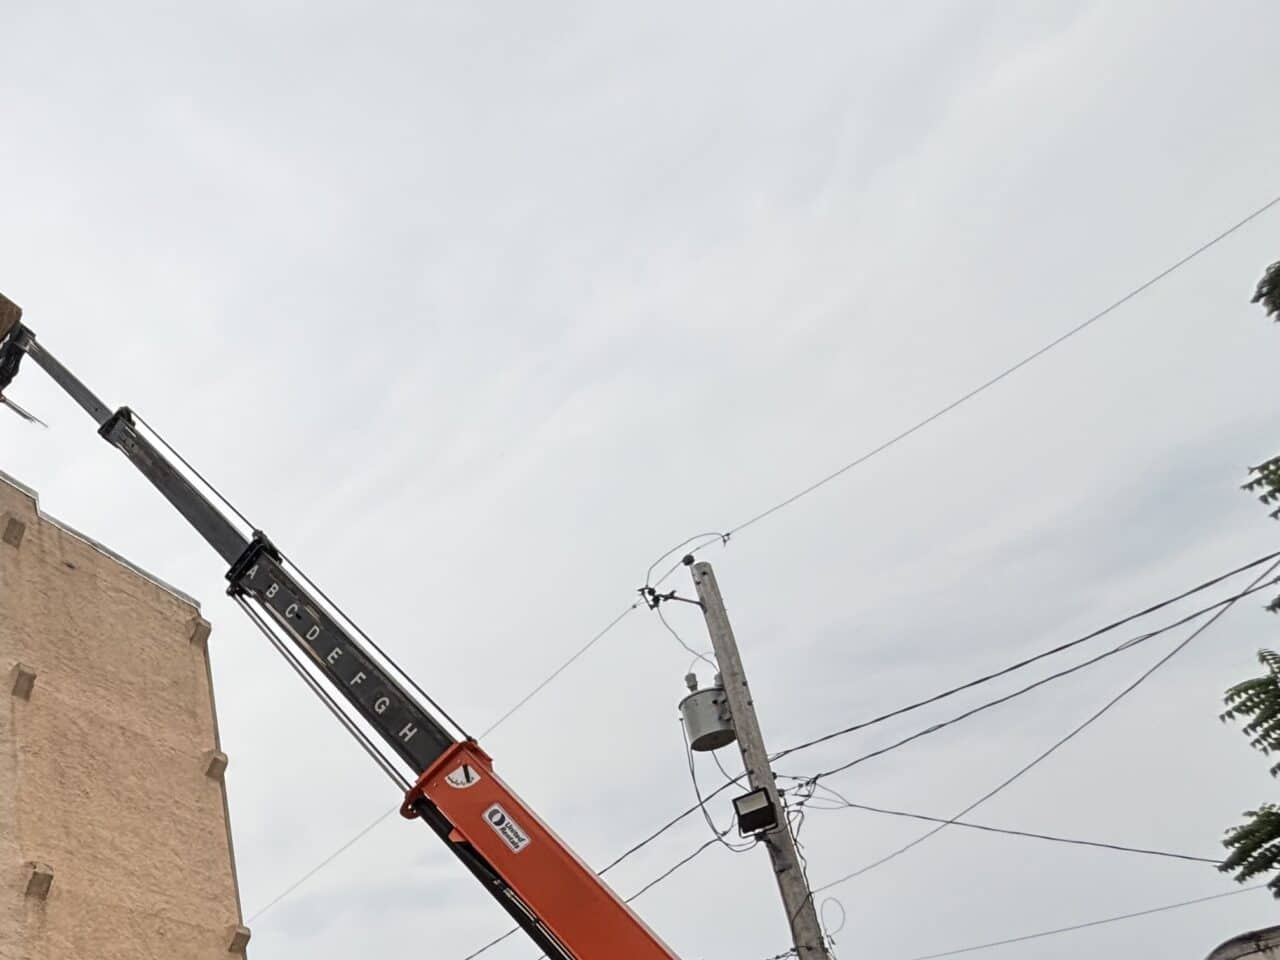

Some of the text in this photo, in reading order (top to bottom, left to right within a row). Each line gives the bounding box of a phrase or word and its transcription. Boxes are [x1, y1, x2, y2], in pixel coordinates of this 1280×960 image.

[246, 565, 418, 742] A B C D E F G H
[500, 827, 520, 849] Rentals
[504, 822, 526, 843] United
